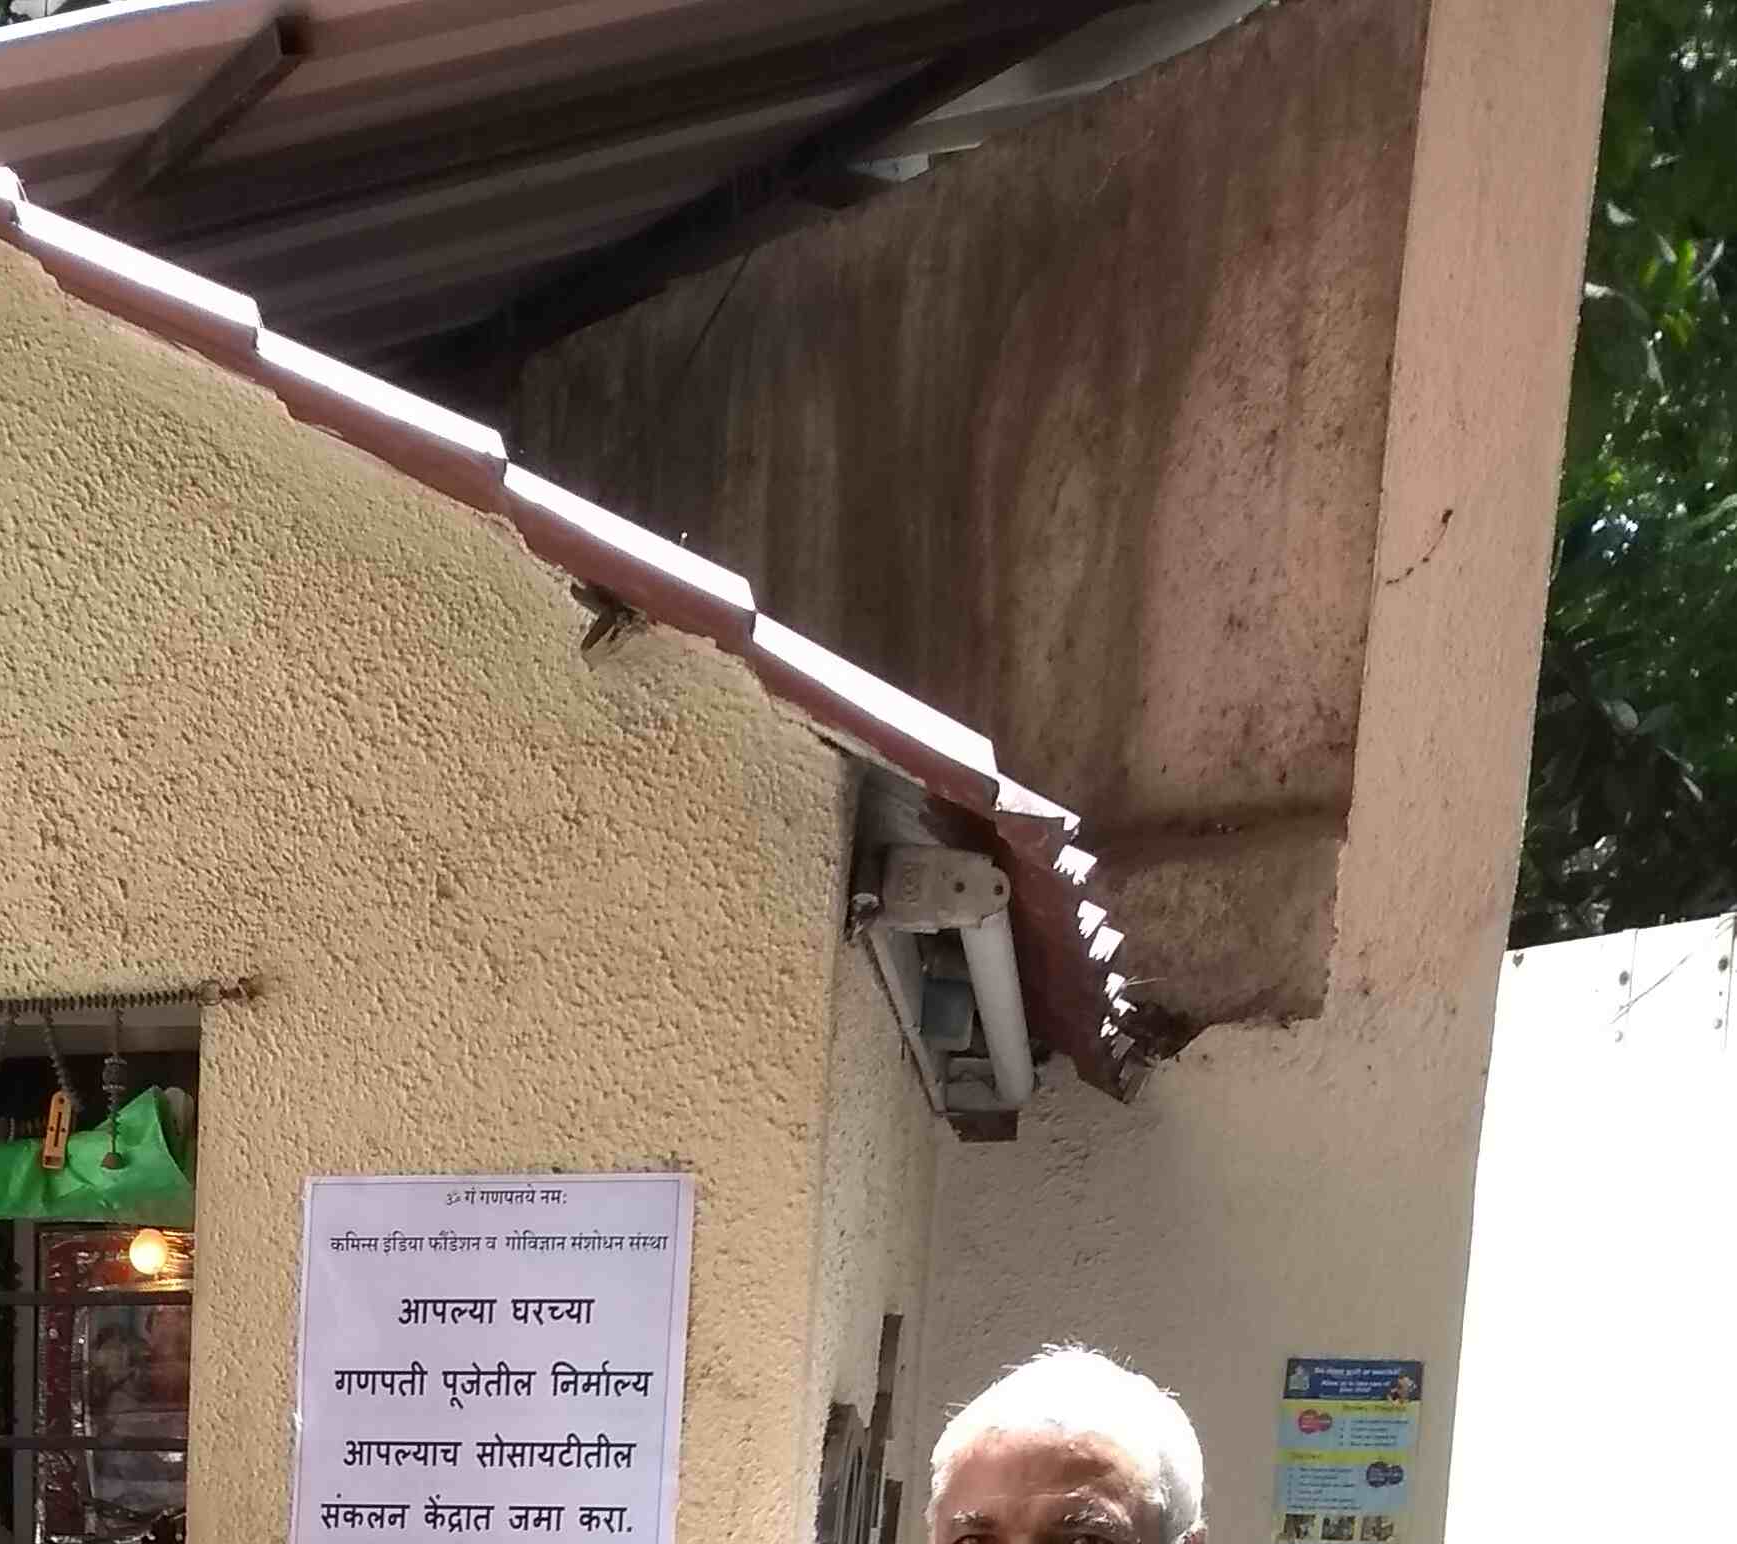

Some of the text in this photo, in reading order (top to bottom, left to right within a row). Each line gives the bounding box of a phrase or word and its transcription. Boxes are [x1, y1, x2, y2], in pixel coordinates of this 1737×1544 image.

[479, 1184, 535, 1206] गणपतये
[330, 1231, 378, 1253] कमिन्स
[382, 1233, 423, 1255] इंडिया
[486, 1237, 496, 1251] व
[571, 1230, 624, 1252] संशोधन
[627, 1232, 668, 1252] संस्था
[399, 1297, 595, 1326] आपल्या घरच्या
[334, 1360, 653, 1409] गणपती पूजेतील निर्माल्य
[343, 1433, 636, 1469] आपल्याच सोसायटीतील
[320, 1492, 633, 1534] संकलन केंद्रात जमा करा.
